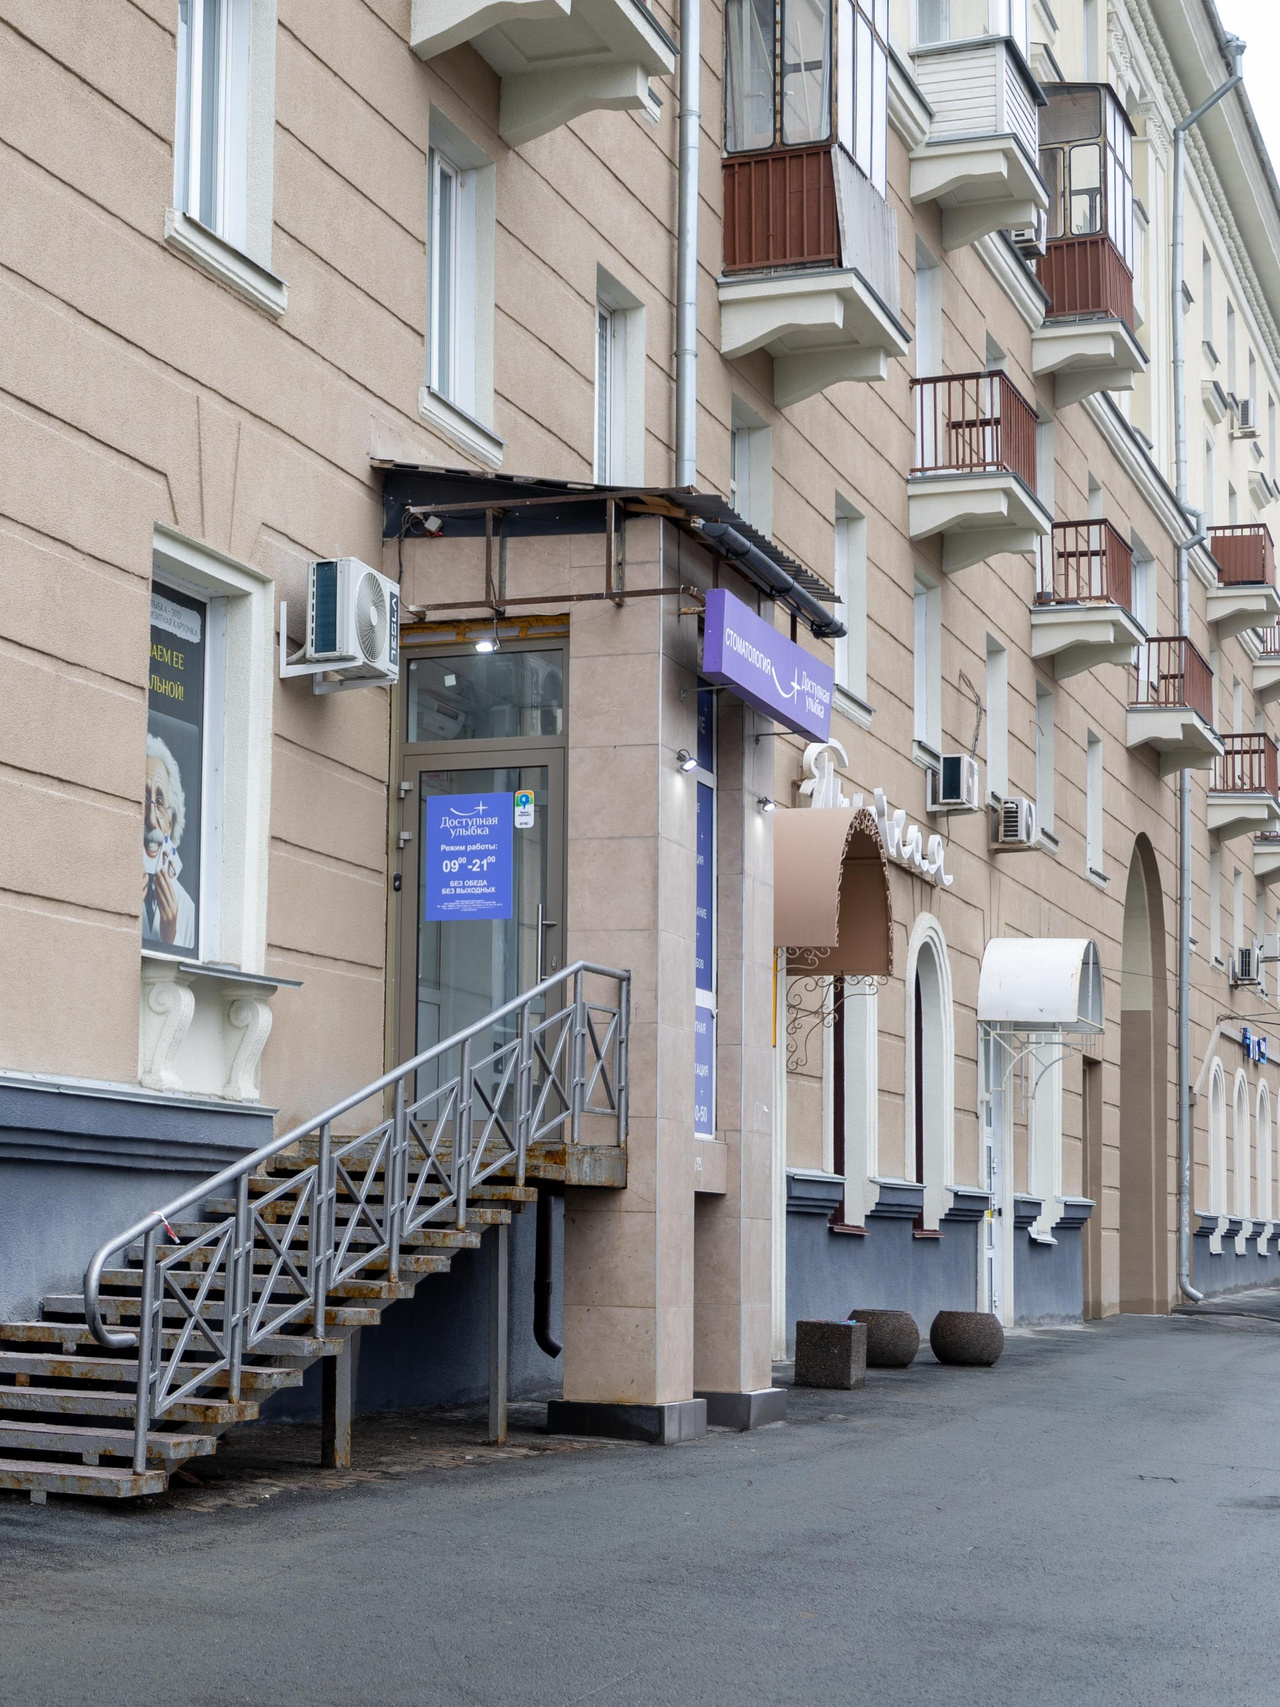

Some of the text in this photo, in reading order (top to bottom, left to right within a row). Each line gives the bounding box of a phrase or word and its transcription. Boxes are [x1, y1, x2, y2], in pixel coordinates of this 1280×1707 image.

[173, 651, 184, 670] ЕЕ
[725, 627, 771, 676] СТОМАТОЛОГИЯ
[148, 674, 184, 701] ЛЬНОЙ!
[801, 670, 831, 705] Доступная
[805, 695, 825, 719] улыбка
[440, 816, 498, 829] Доступная
[450, 825, 489, 838] улыбка
[440, 843, 498, 852] Режим работы:
[464, 879, 488, 887] ОБЕДА
